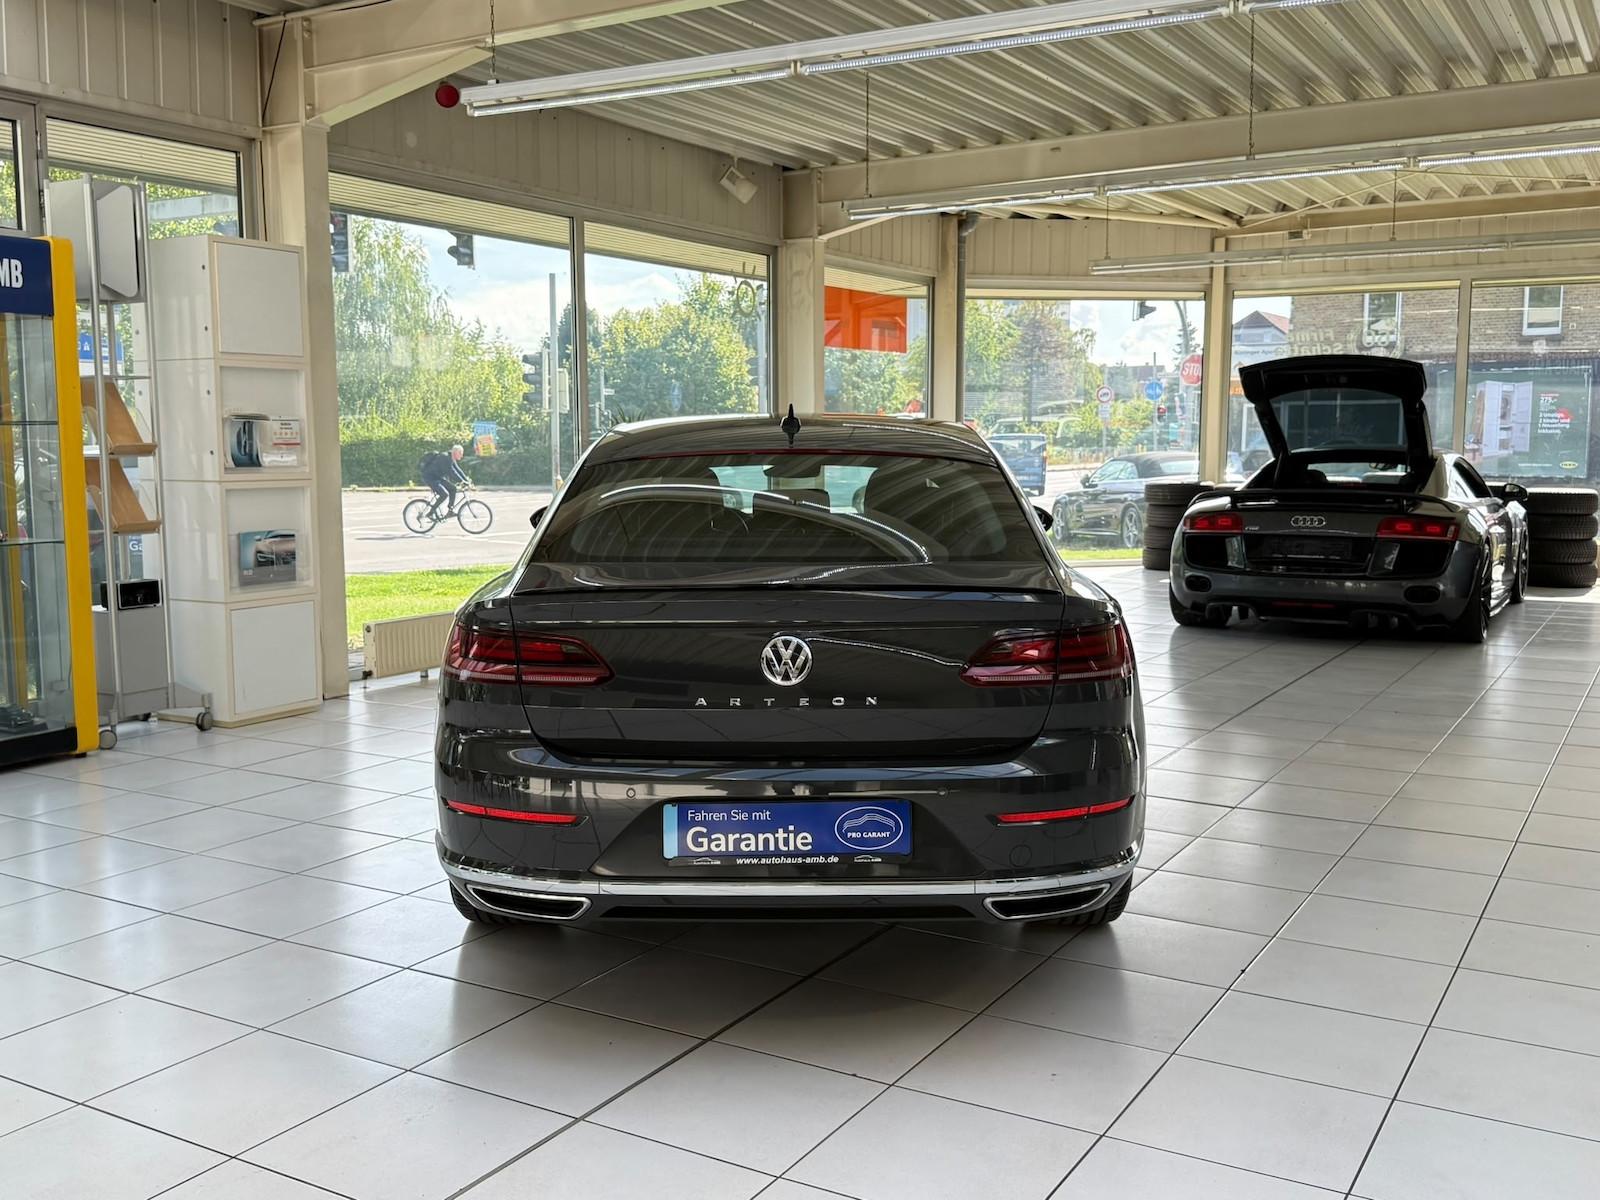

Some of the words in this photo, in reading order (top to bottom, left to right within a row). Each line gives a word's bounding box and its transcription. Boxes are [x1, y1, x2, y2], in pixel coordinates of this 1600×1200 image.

[1182, 362, 1201, 376] STO
[695, 696, 878, 707] ARTEON
[687, 810, 728, 821] Fahren
[731, 809, 749, 821] Sie
[752, 809, 771, 821] mit
[686, 825, 813, 852] Garantie
[736, 855, 840, 865] www.autohaus-amb.de
